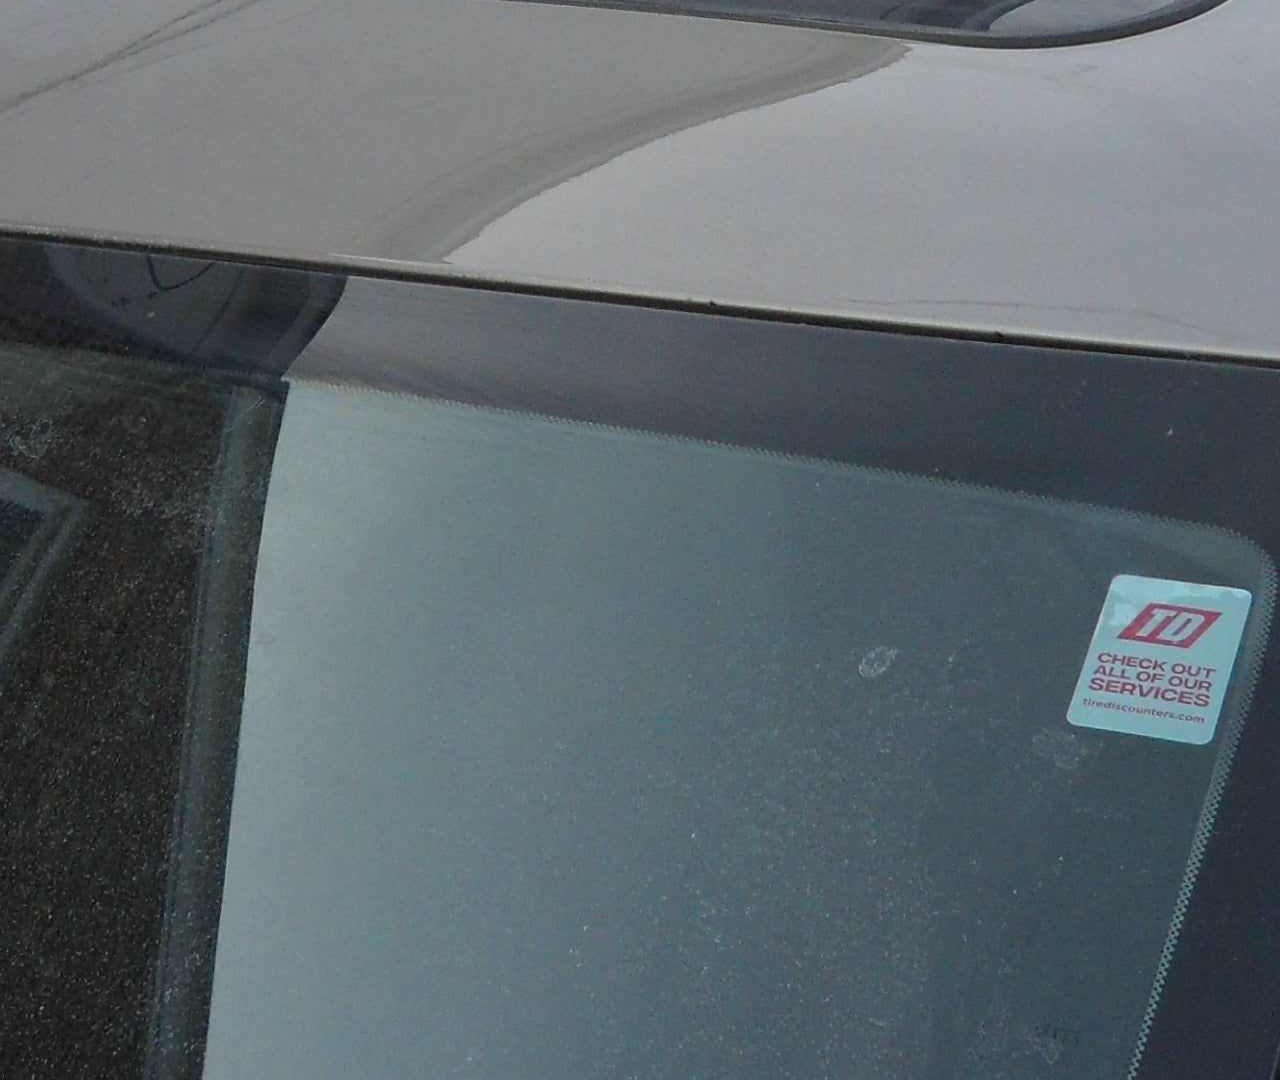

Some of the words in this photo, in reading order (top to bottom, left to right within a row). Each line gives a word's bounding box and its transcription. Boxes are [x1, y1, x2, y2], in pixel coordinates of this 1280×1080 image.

[1135, 608, 1206, 643] TD
[1093, 665, 1131, 681] ALL
[1136, 671, 1166, 685] OF
[1168, 675, 1213, 693] OUR
[1097, 652, 1168, 672] CHECK
[1171, 663, 1217, 679] OUT
[1088, 678, 1211, 708] SERVICES
[1082, 698, 1205, 724] tirediscounters.com
